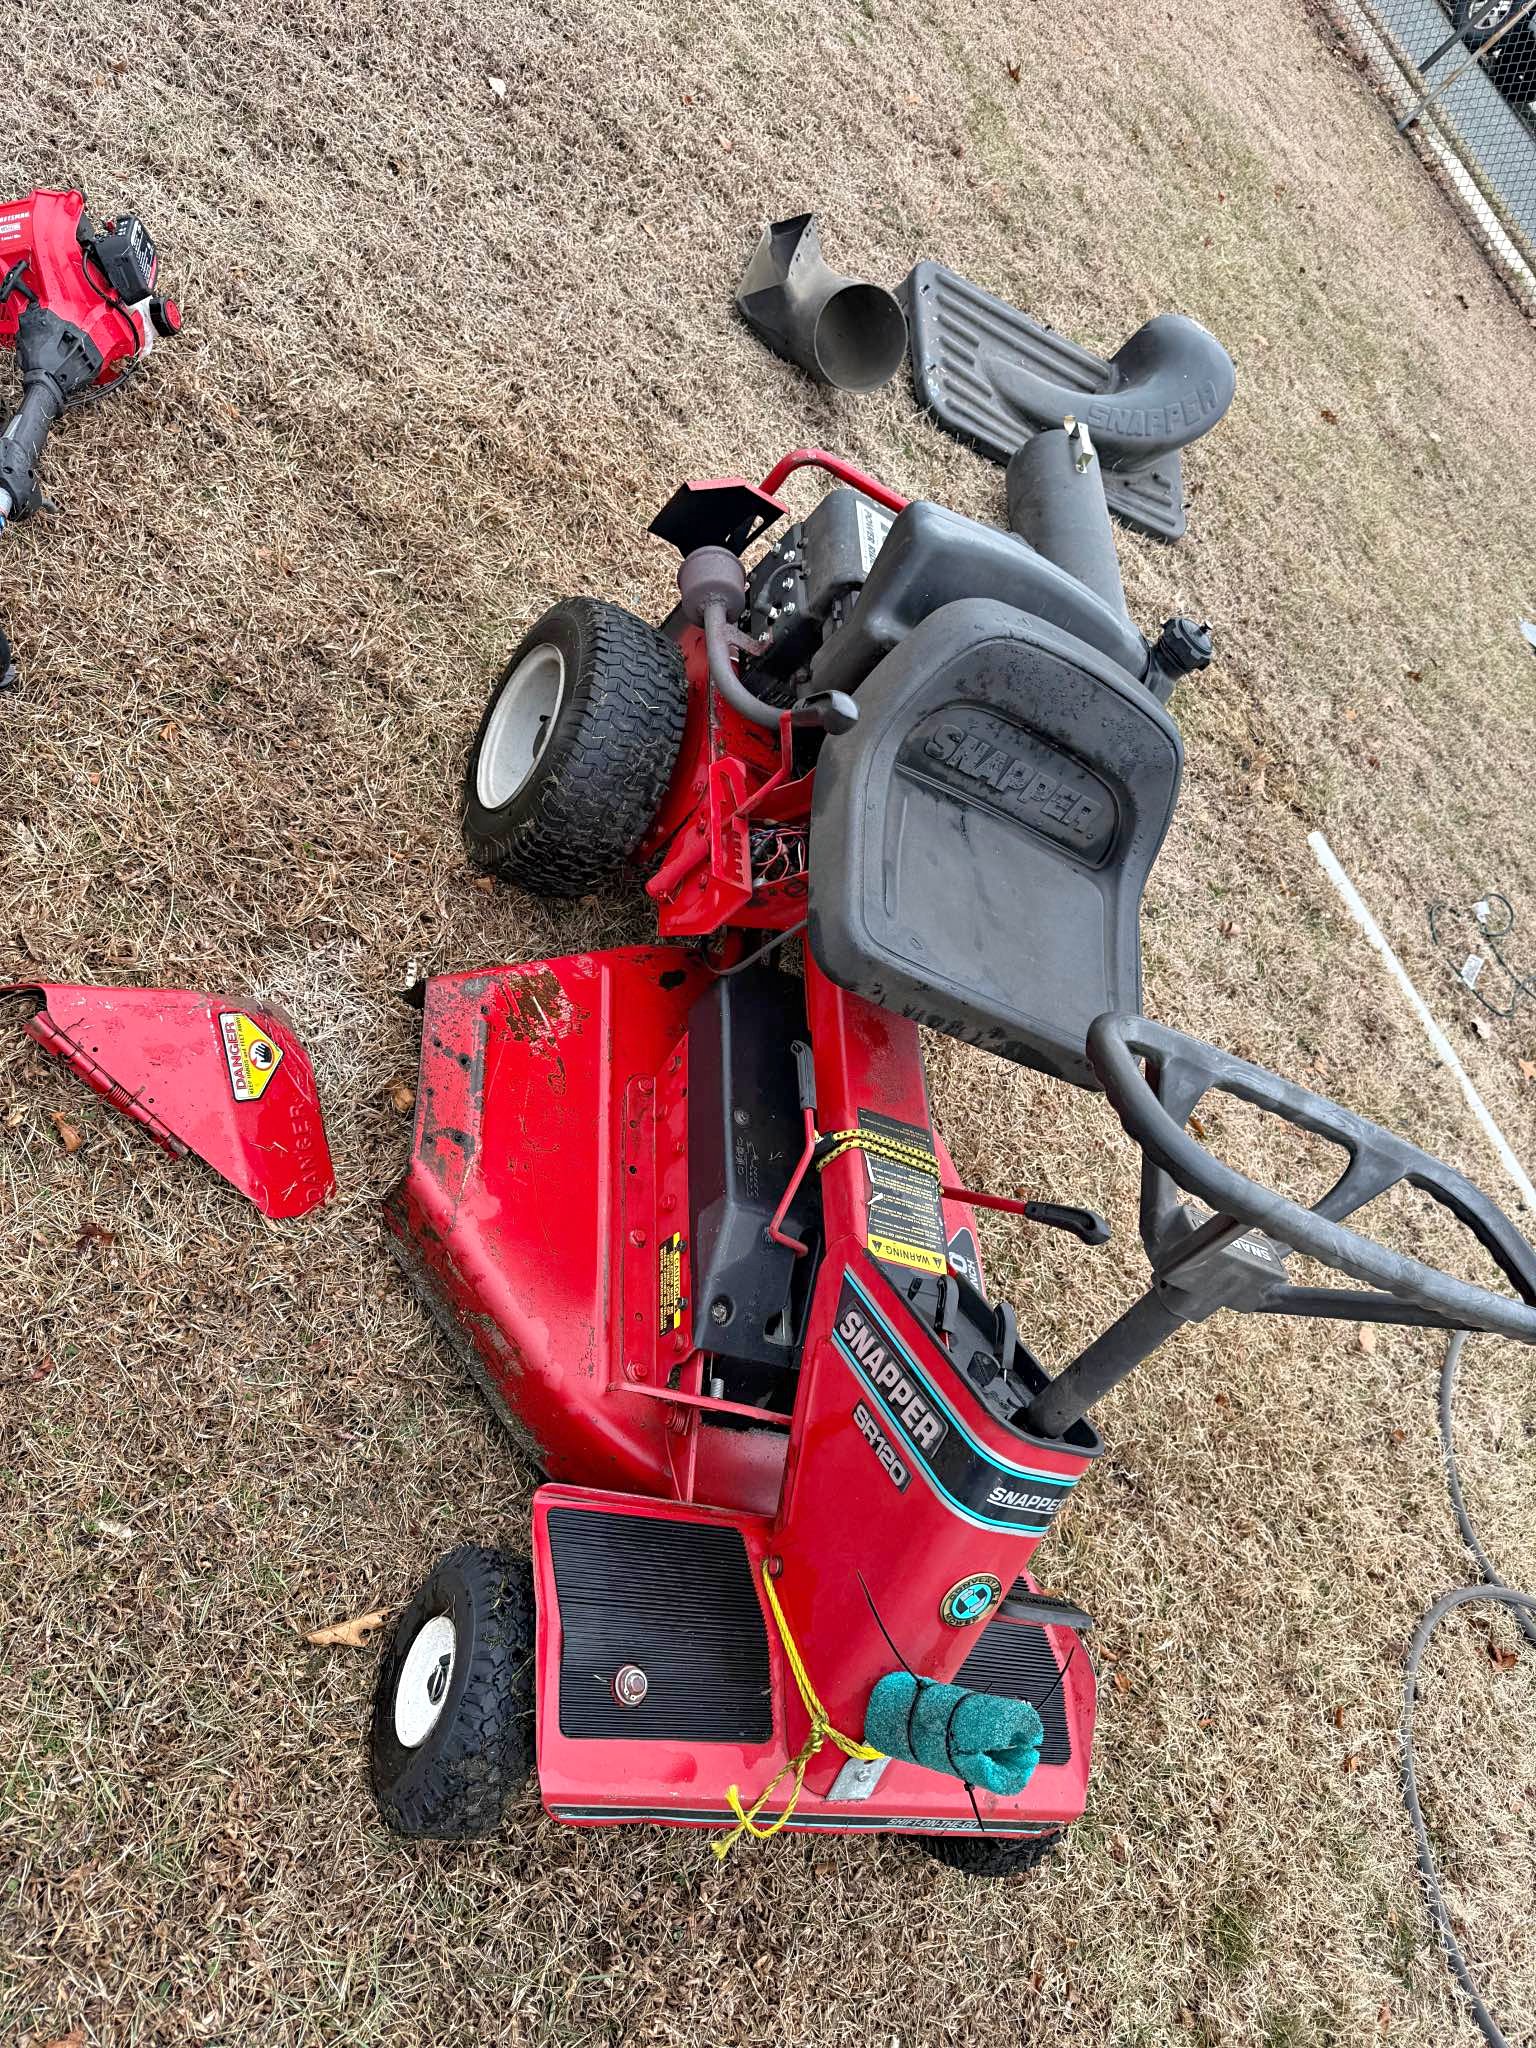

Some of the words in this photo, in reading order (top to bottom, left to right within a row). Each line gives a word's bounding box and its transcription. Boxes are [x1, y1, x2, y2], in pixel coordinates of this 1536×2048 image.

[1087, 380, 1218, 437] SNAPPER
[864, 508, 875, 544] POWER
[923, 724, 1103, 833] SNAPPER
[225, 1022, 247, 1090] DANGER
[290, 1103, 322, 1203] DANGER
[885, 1245, 931, 1265] WARNING
[948, 1251, 967, 1275] 0
[839, 1311, 939, 1449] SNAPPER
[853, 1404, 907, 1487] SR120
[988, 1487, 1066, 1511] SNAPPER
[886, 1818, 979, 1829] SHIFT-ON-THE-GO
